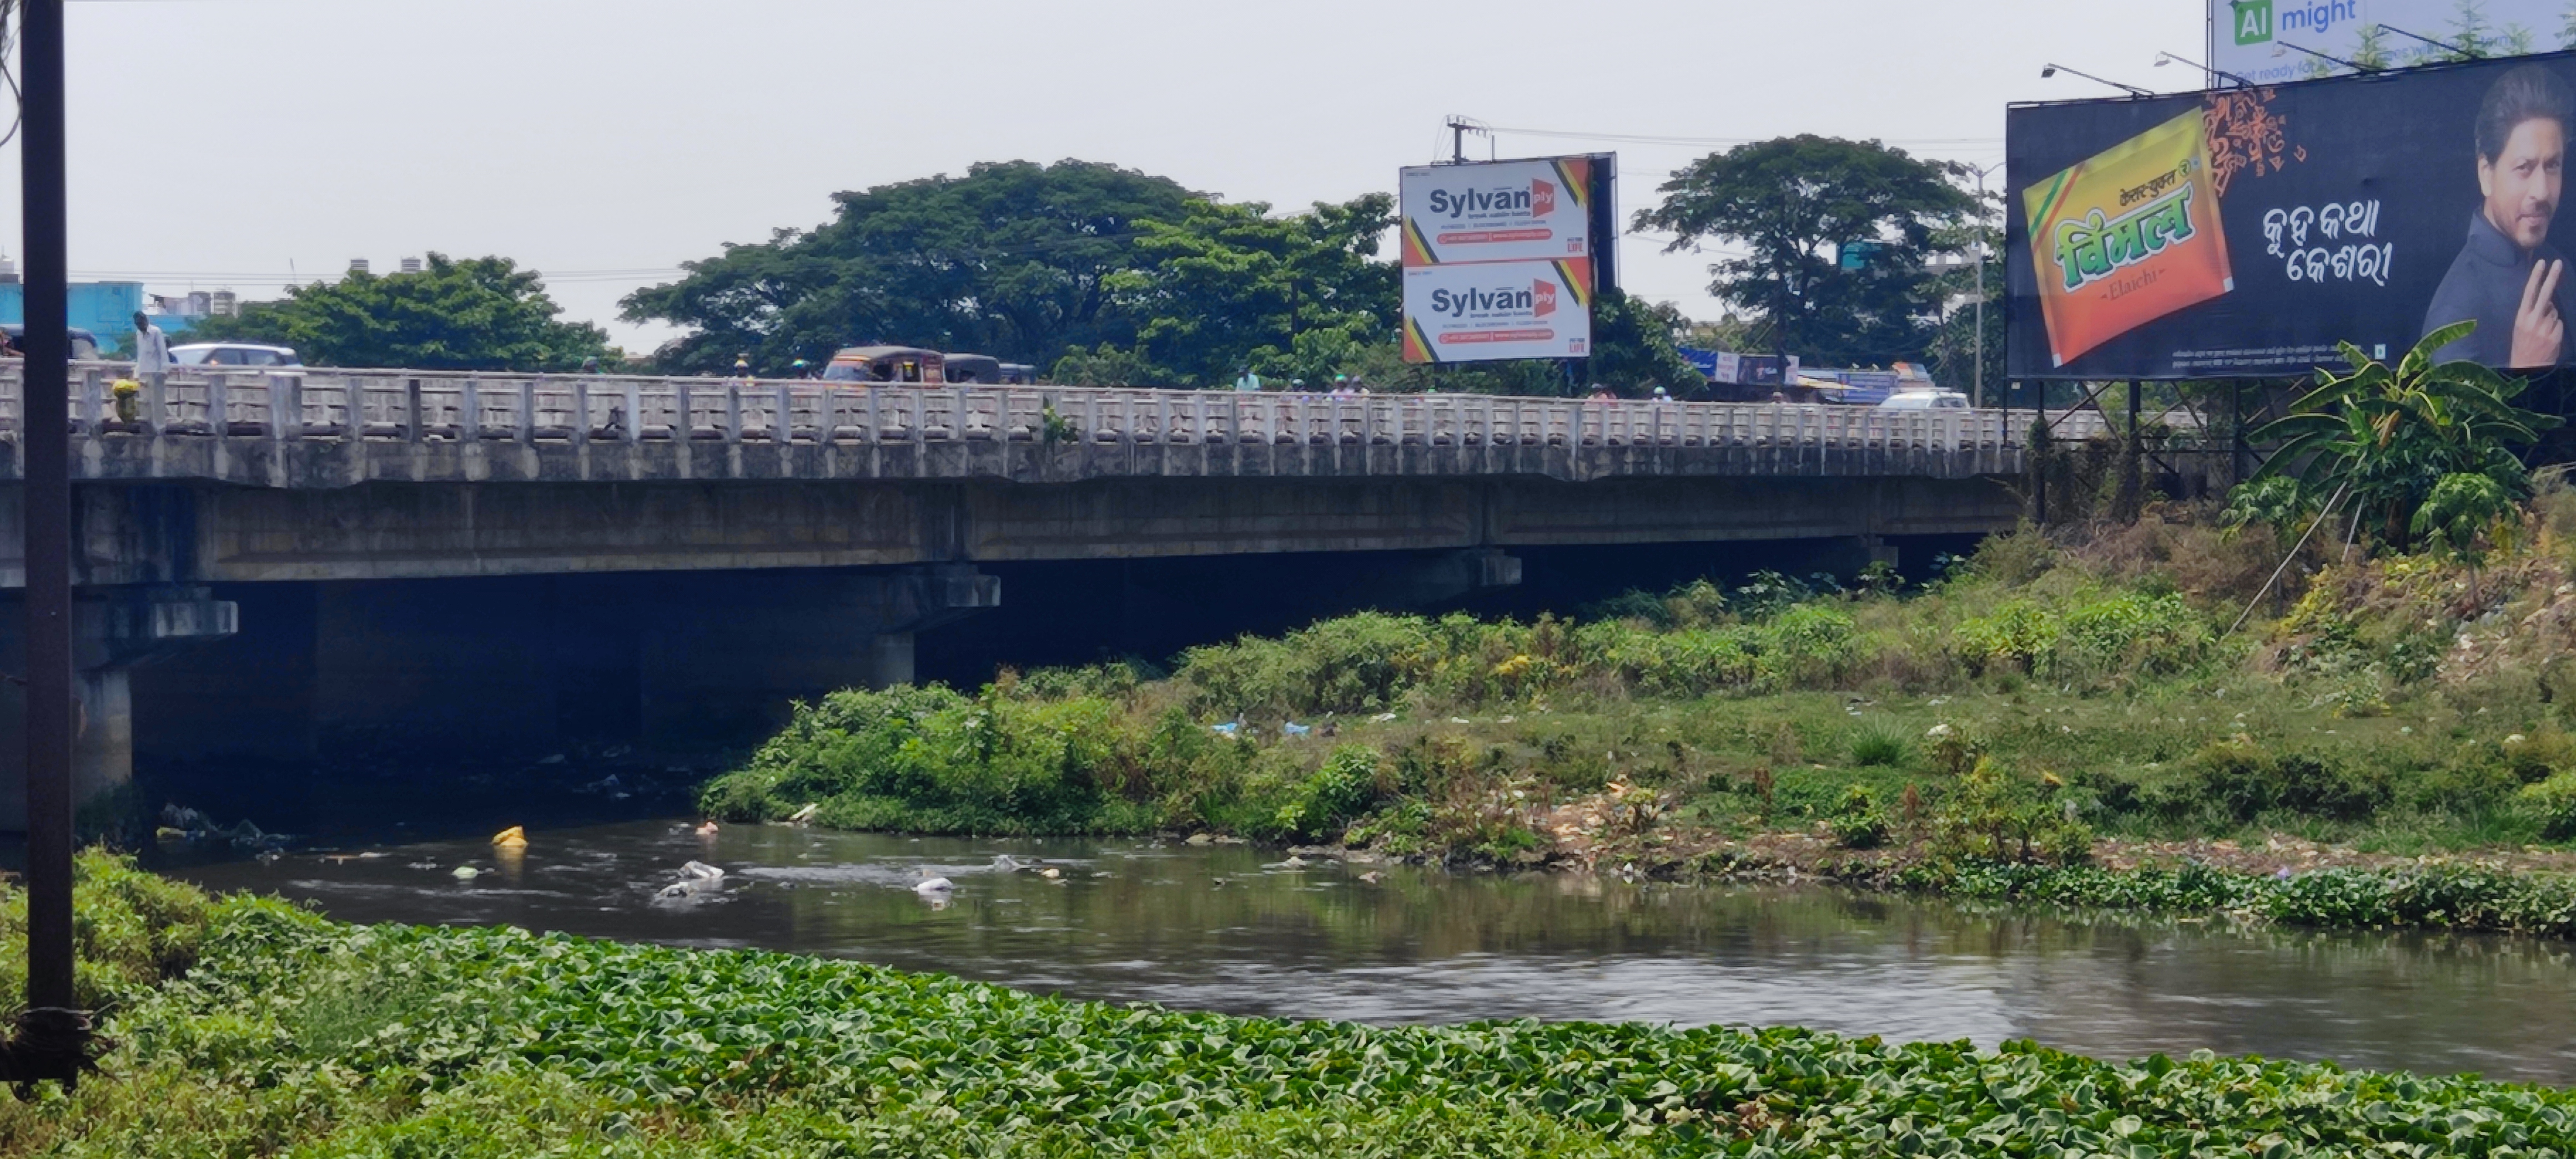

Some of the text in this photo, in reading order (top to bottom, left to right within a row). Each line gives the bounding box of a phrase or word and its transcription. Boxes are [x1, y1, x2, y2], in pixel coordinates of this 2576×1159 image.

[2240, 0, 2356, 38] AI might
[2259, 62, 2295, 81] ready
[1533, 191, 1553, 205] ply
[2056, 187, 2193, 289] विमल
[2263, 199, 2380, 259] କୁହ କଥା
[2287, 241, 2393, 287] କେଶରୀ
[1534, 291, 1554, 305] ply
[2109, 265, 2157, 300] Elaichi
